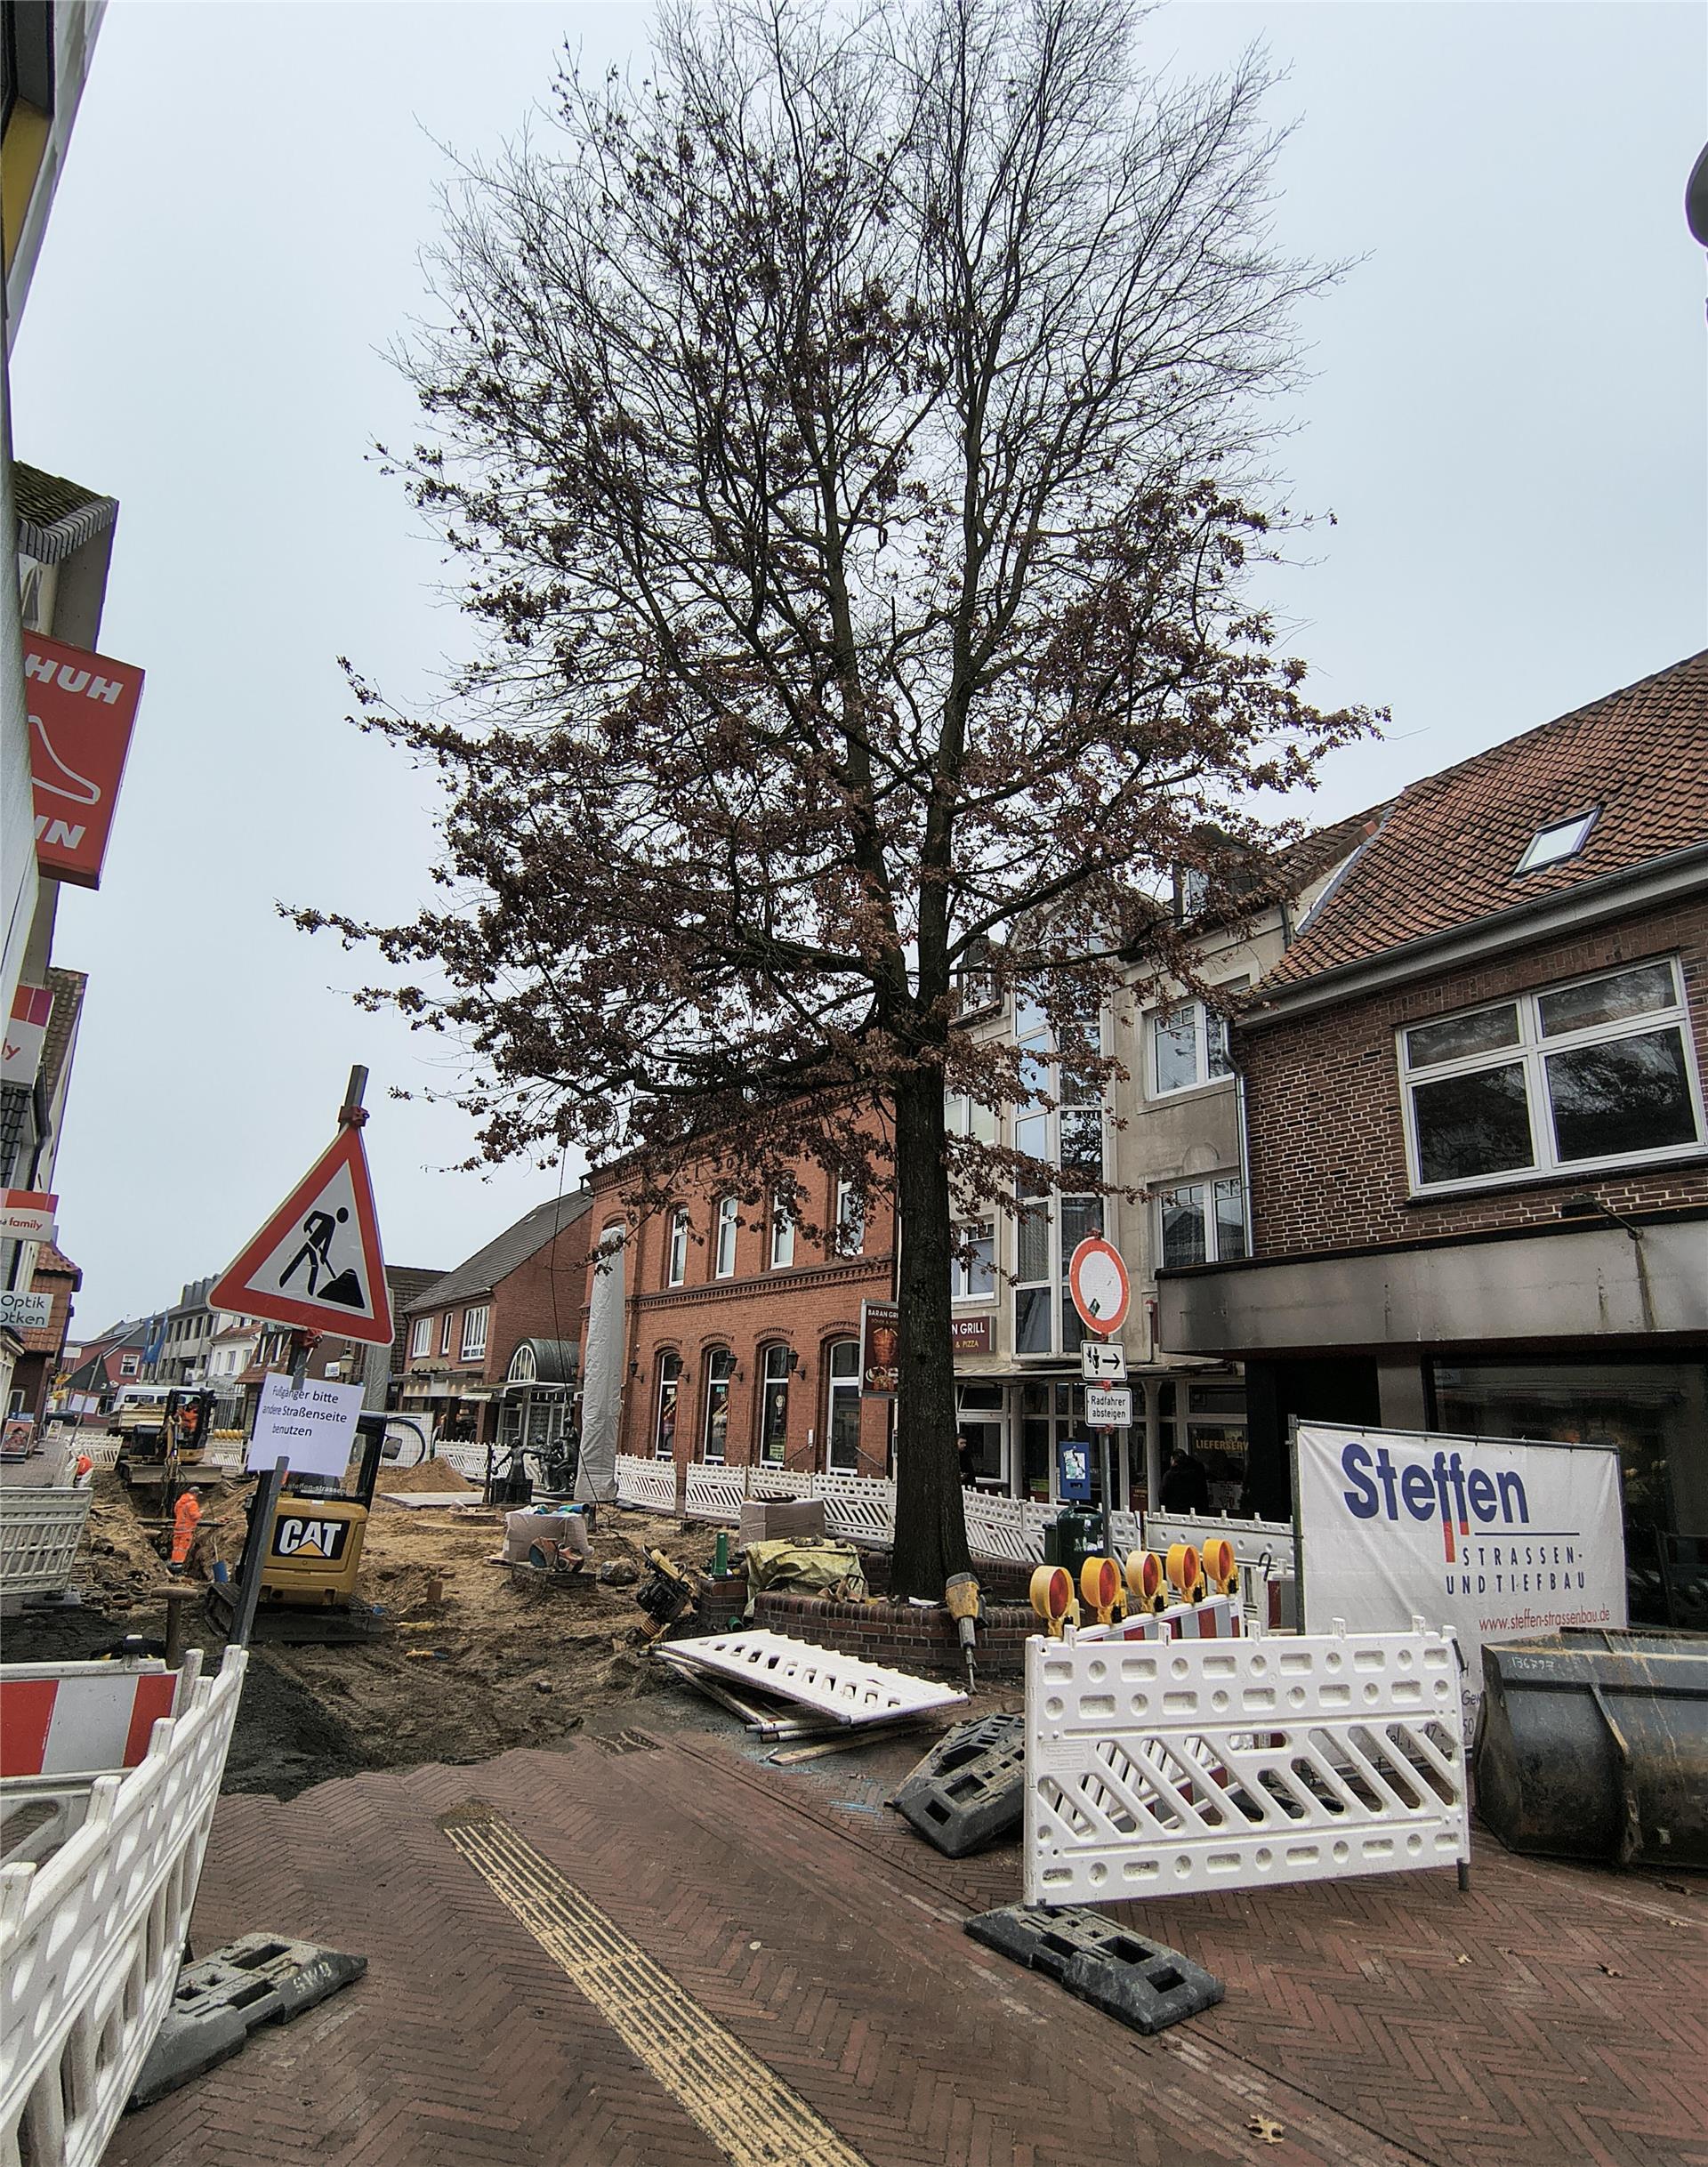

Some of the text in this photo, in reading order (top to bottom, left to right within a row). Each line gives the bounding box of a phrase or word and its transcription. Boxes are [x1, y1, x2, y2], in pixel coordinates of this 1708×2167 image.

[9, 1216, 44, 1231] family
[1, 1294, 45, 1310] Optik
[0, 1310, 45, 1325] Otken
[960, 1321, 986, 1335] GRILL
[963, 1340, 979, 1349] PIZZA
[312, 1390, 340, 1405] bitte
[1091, 1395, 1126, 1407] Radfahrer
[262, 1403, 348, 1423] andere Straßenseite
[1092, 1409, 1126, 1421] absteigen
[271, 1422, 312, 1437] benutzen
[1341, 1443, 1529, 1563] Steffen
[278, 1519, 342, 1558] CAT
[1462, 1546, 1583, 1567] STRASSEN-
[1495, 1571, 1585, 1593] TIEFBAU
[1478, 1602, 1610, 1631] www.steffen-strassenbau.de
